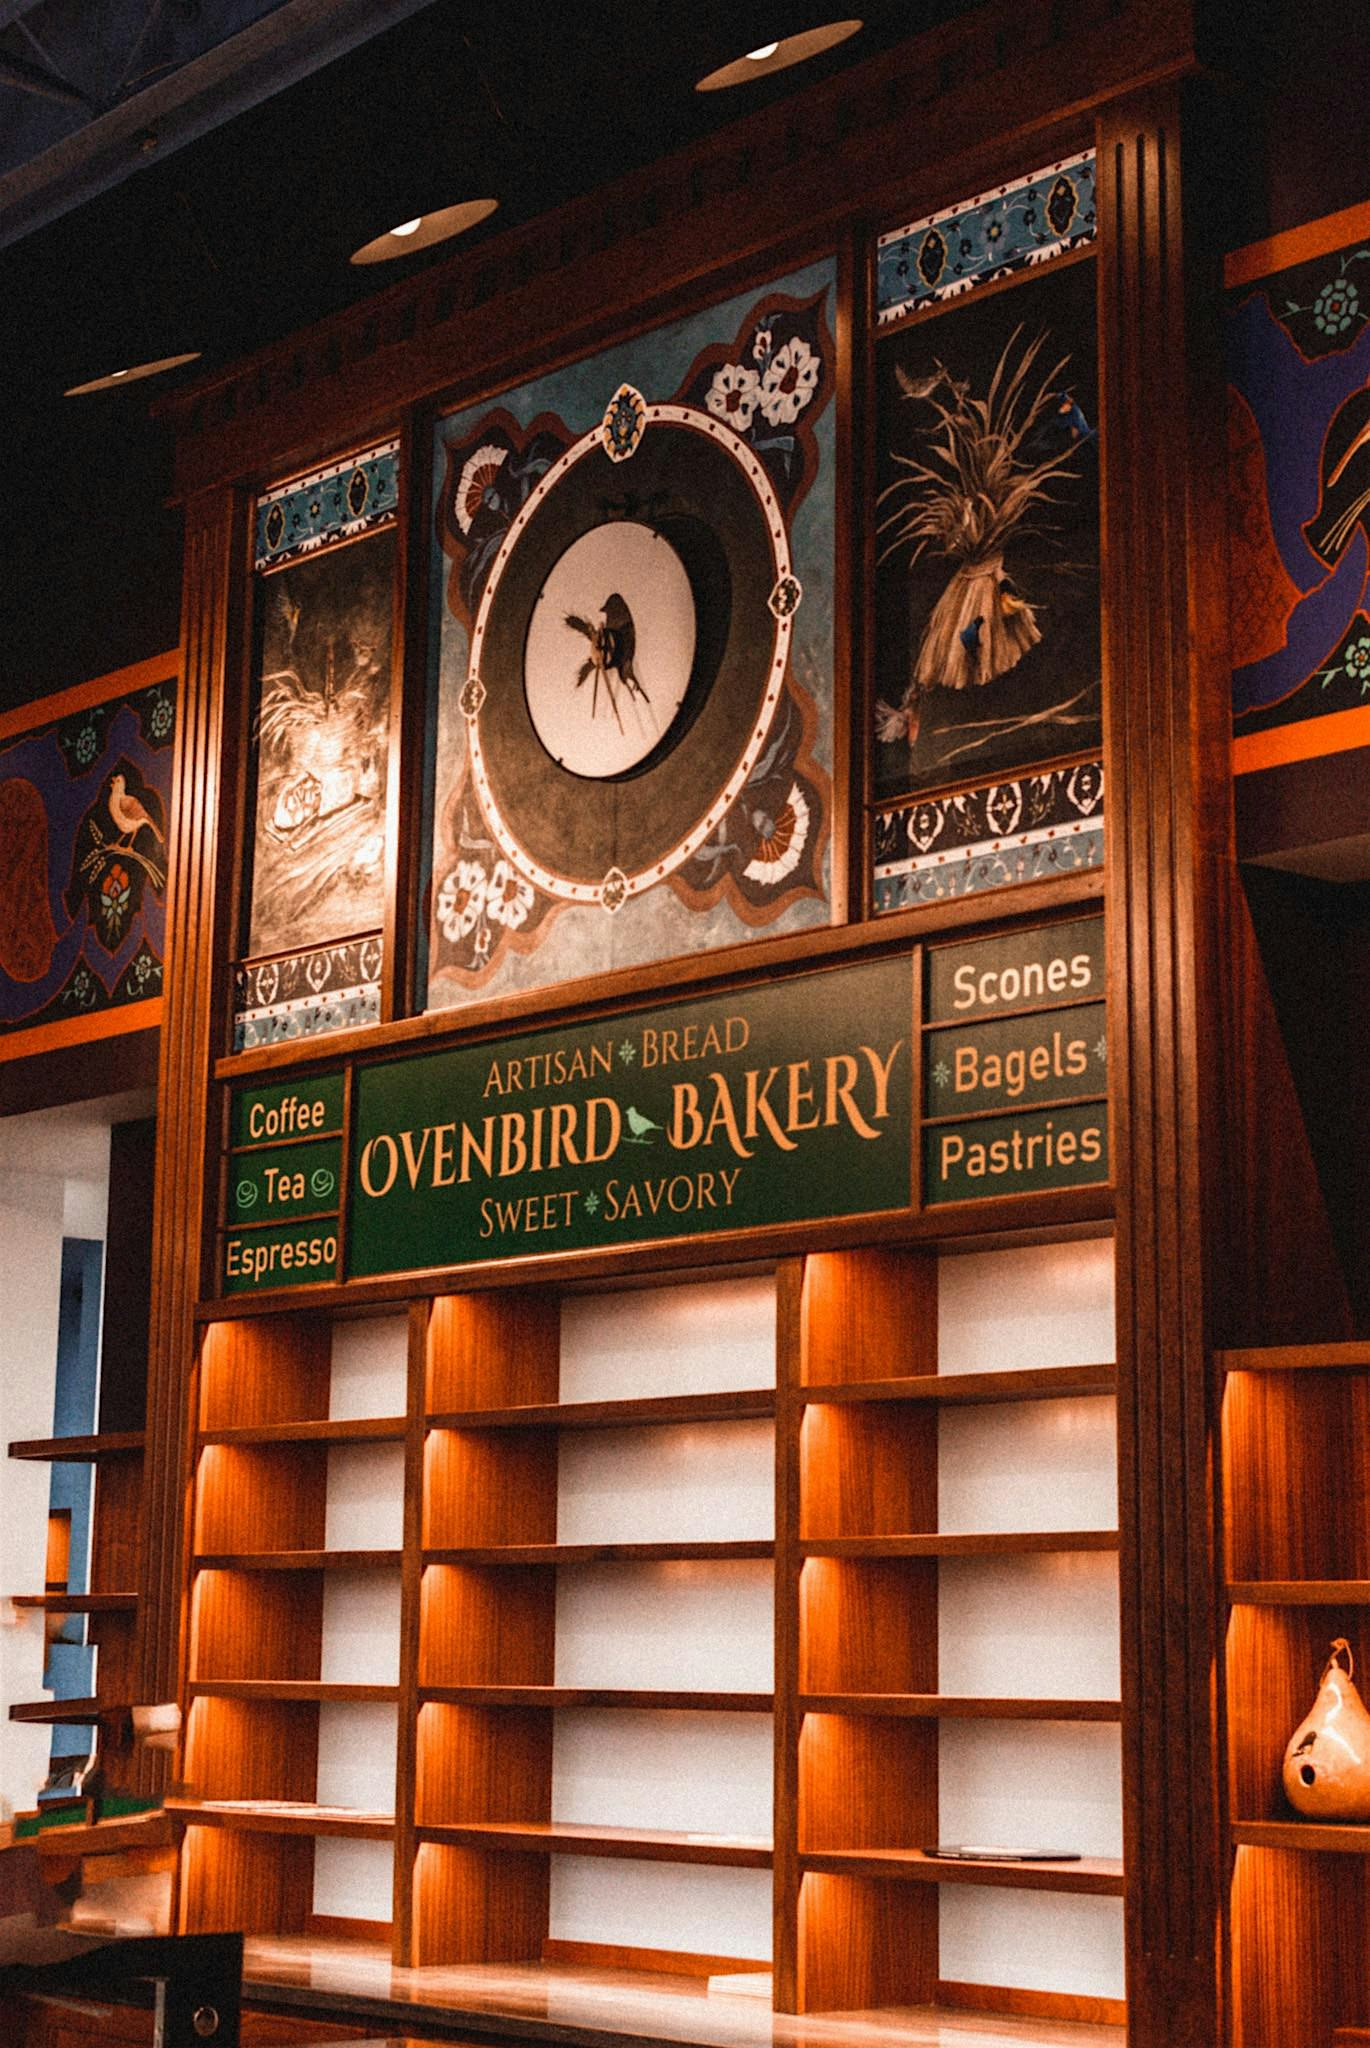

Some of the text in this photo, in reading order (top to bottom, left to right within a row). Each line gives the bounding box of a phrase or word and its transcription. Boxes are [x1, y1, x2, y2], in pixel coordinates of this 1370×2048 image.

[952, 953, 1092, 1010] Scones
[482, 1016, 751, 1099] ARTISAN BREAD
[954, 1031, 1088, 1097] Bagels
[249, 1096, 326, 1139] Coffee
[359, 1040, 904, 1199] OVENBIRD BAKERY
[940, 1122, 1101, 1181] Pastries
[263, 1167, 306, 1204] Tea
[479, 1167, 742, 1239] SWEET SAVORY
[226, 1234, 338, 1282] Espresso
